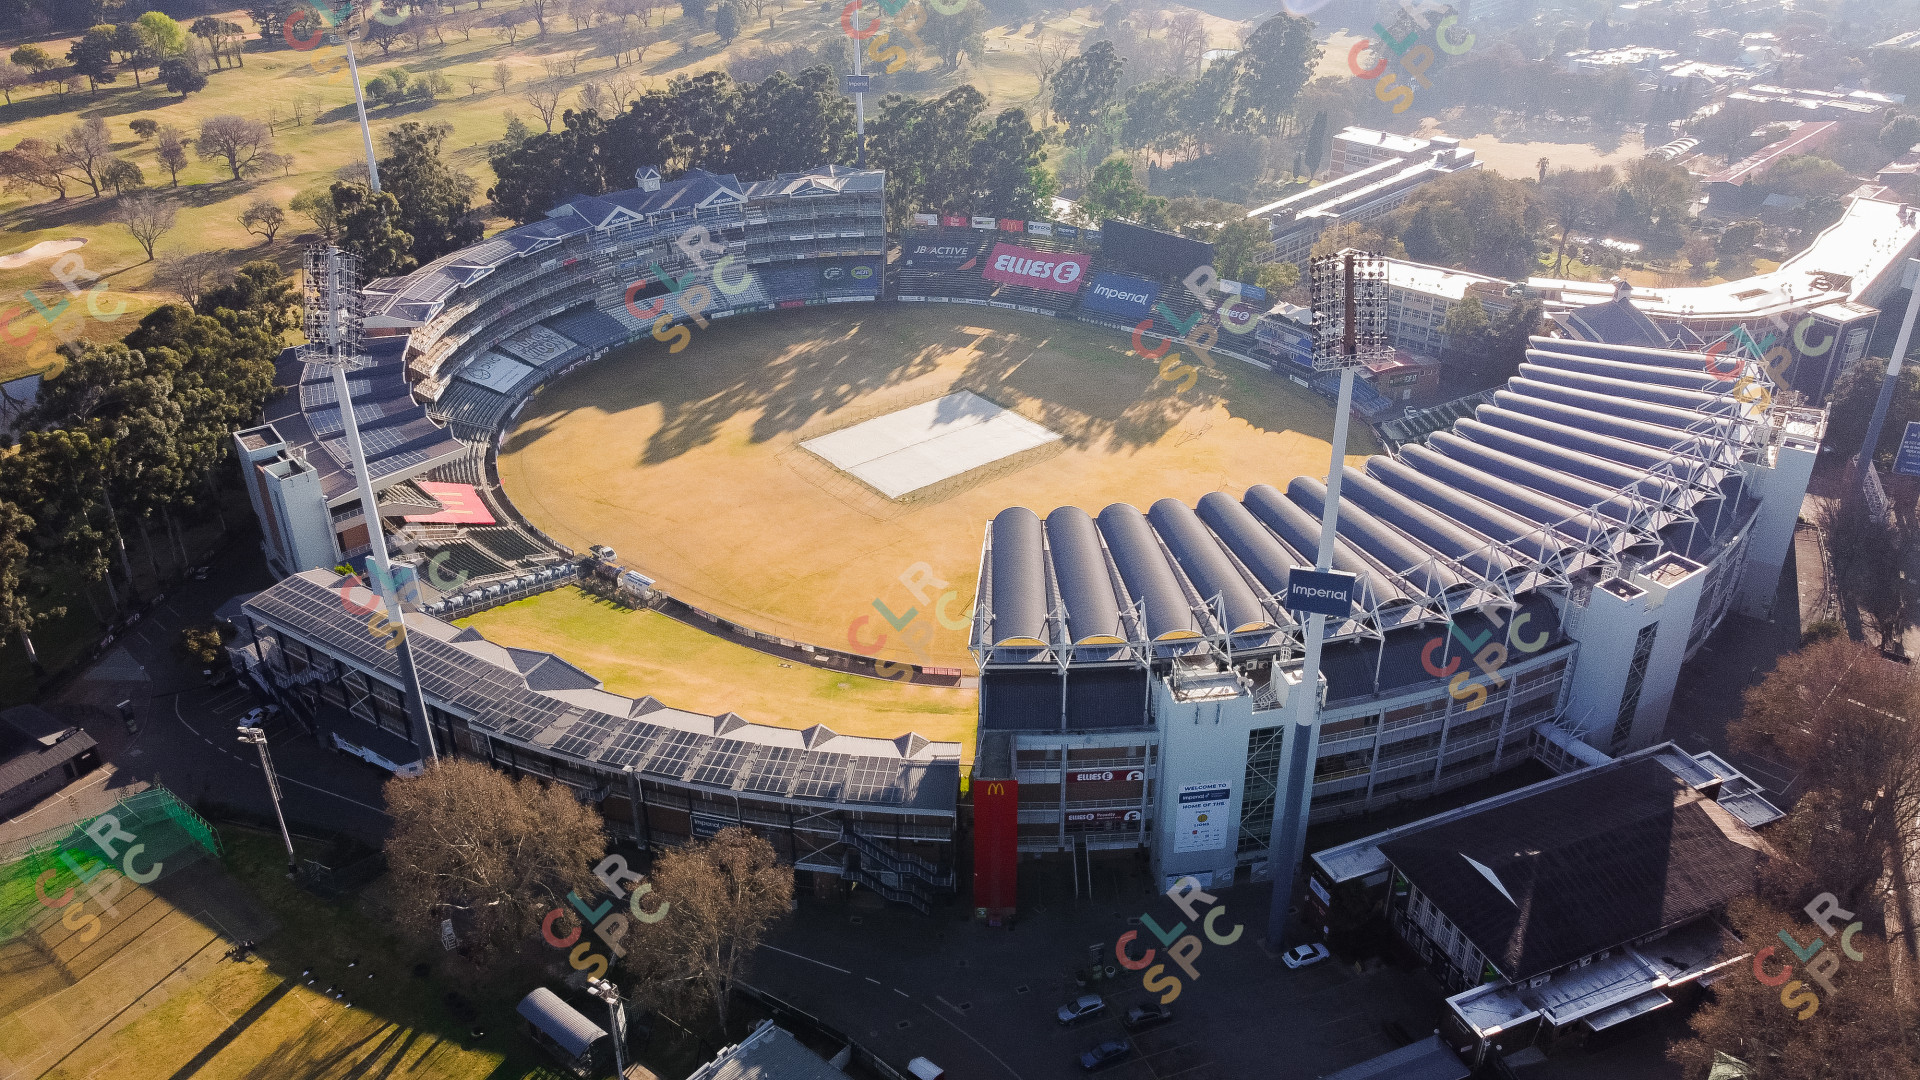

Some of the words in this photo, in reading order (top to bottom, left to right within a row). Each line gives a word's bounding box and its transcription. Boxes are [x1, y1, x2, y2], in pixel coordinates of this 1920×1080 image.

[994, 254, 1055, 279] ELLIES
[1094, 284, 1148, 306] Imperial
[512, 328, 553, 352] BLACK
[1292, 584, 1346, 602] Imperial
